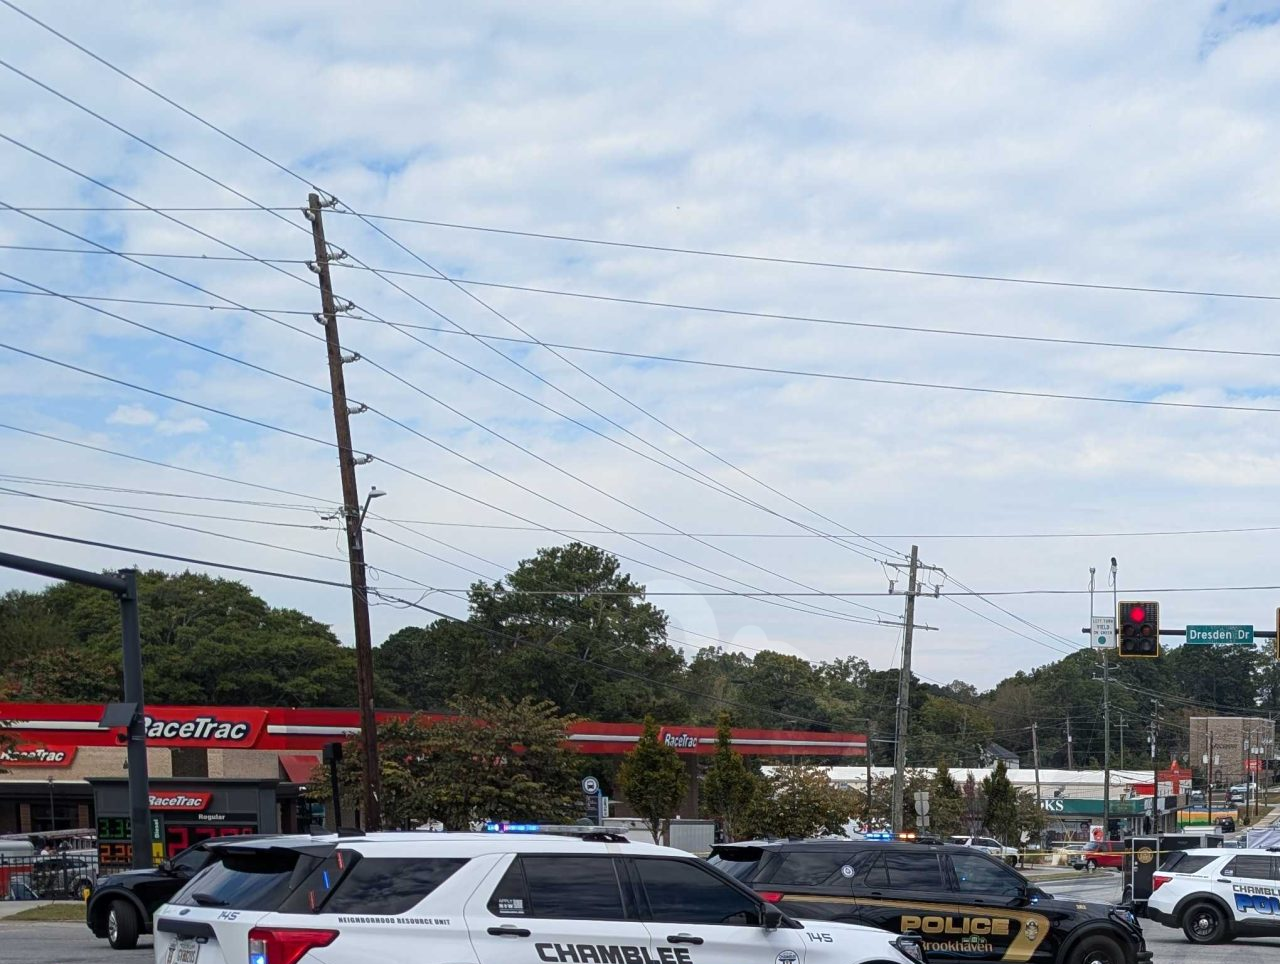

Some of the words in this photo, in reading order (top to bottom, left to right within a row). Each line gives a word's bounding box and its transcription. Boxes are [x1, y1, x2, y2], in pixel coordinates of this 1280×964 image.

[1189, 629, 1232, 640] Dresden
[1237, 630, 1250, 640] Dr
[664, 733, 698, 748] RaceTrac
[198, 813, 226, 821] Regular
[218, 911, 241, 921] 145
[900, 915, 1010, 935] POLICE
[806, 932, 834, 943] 145
[920, 940, 993, 952] Brookhaven
